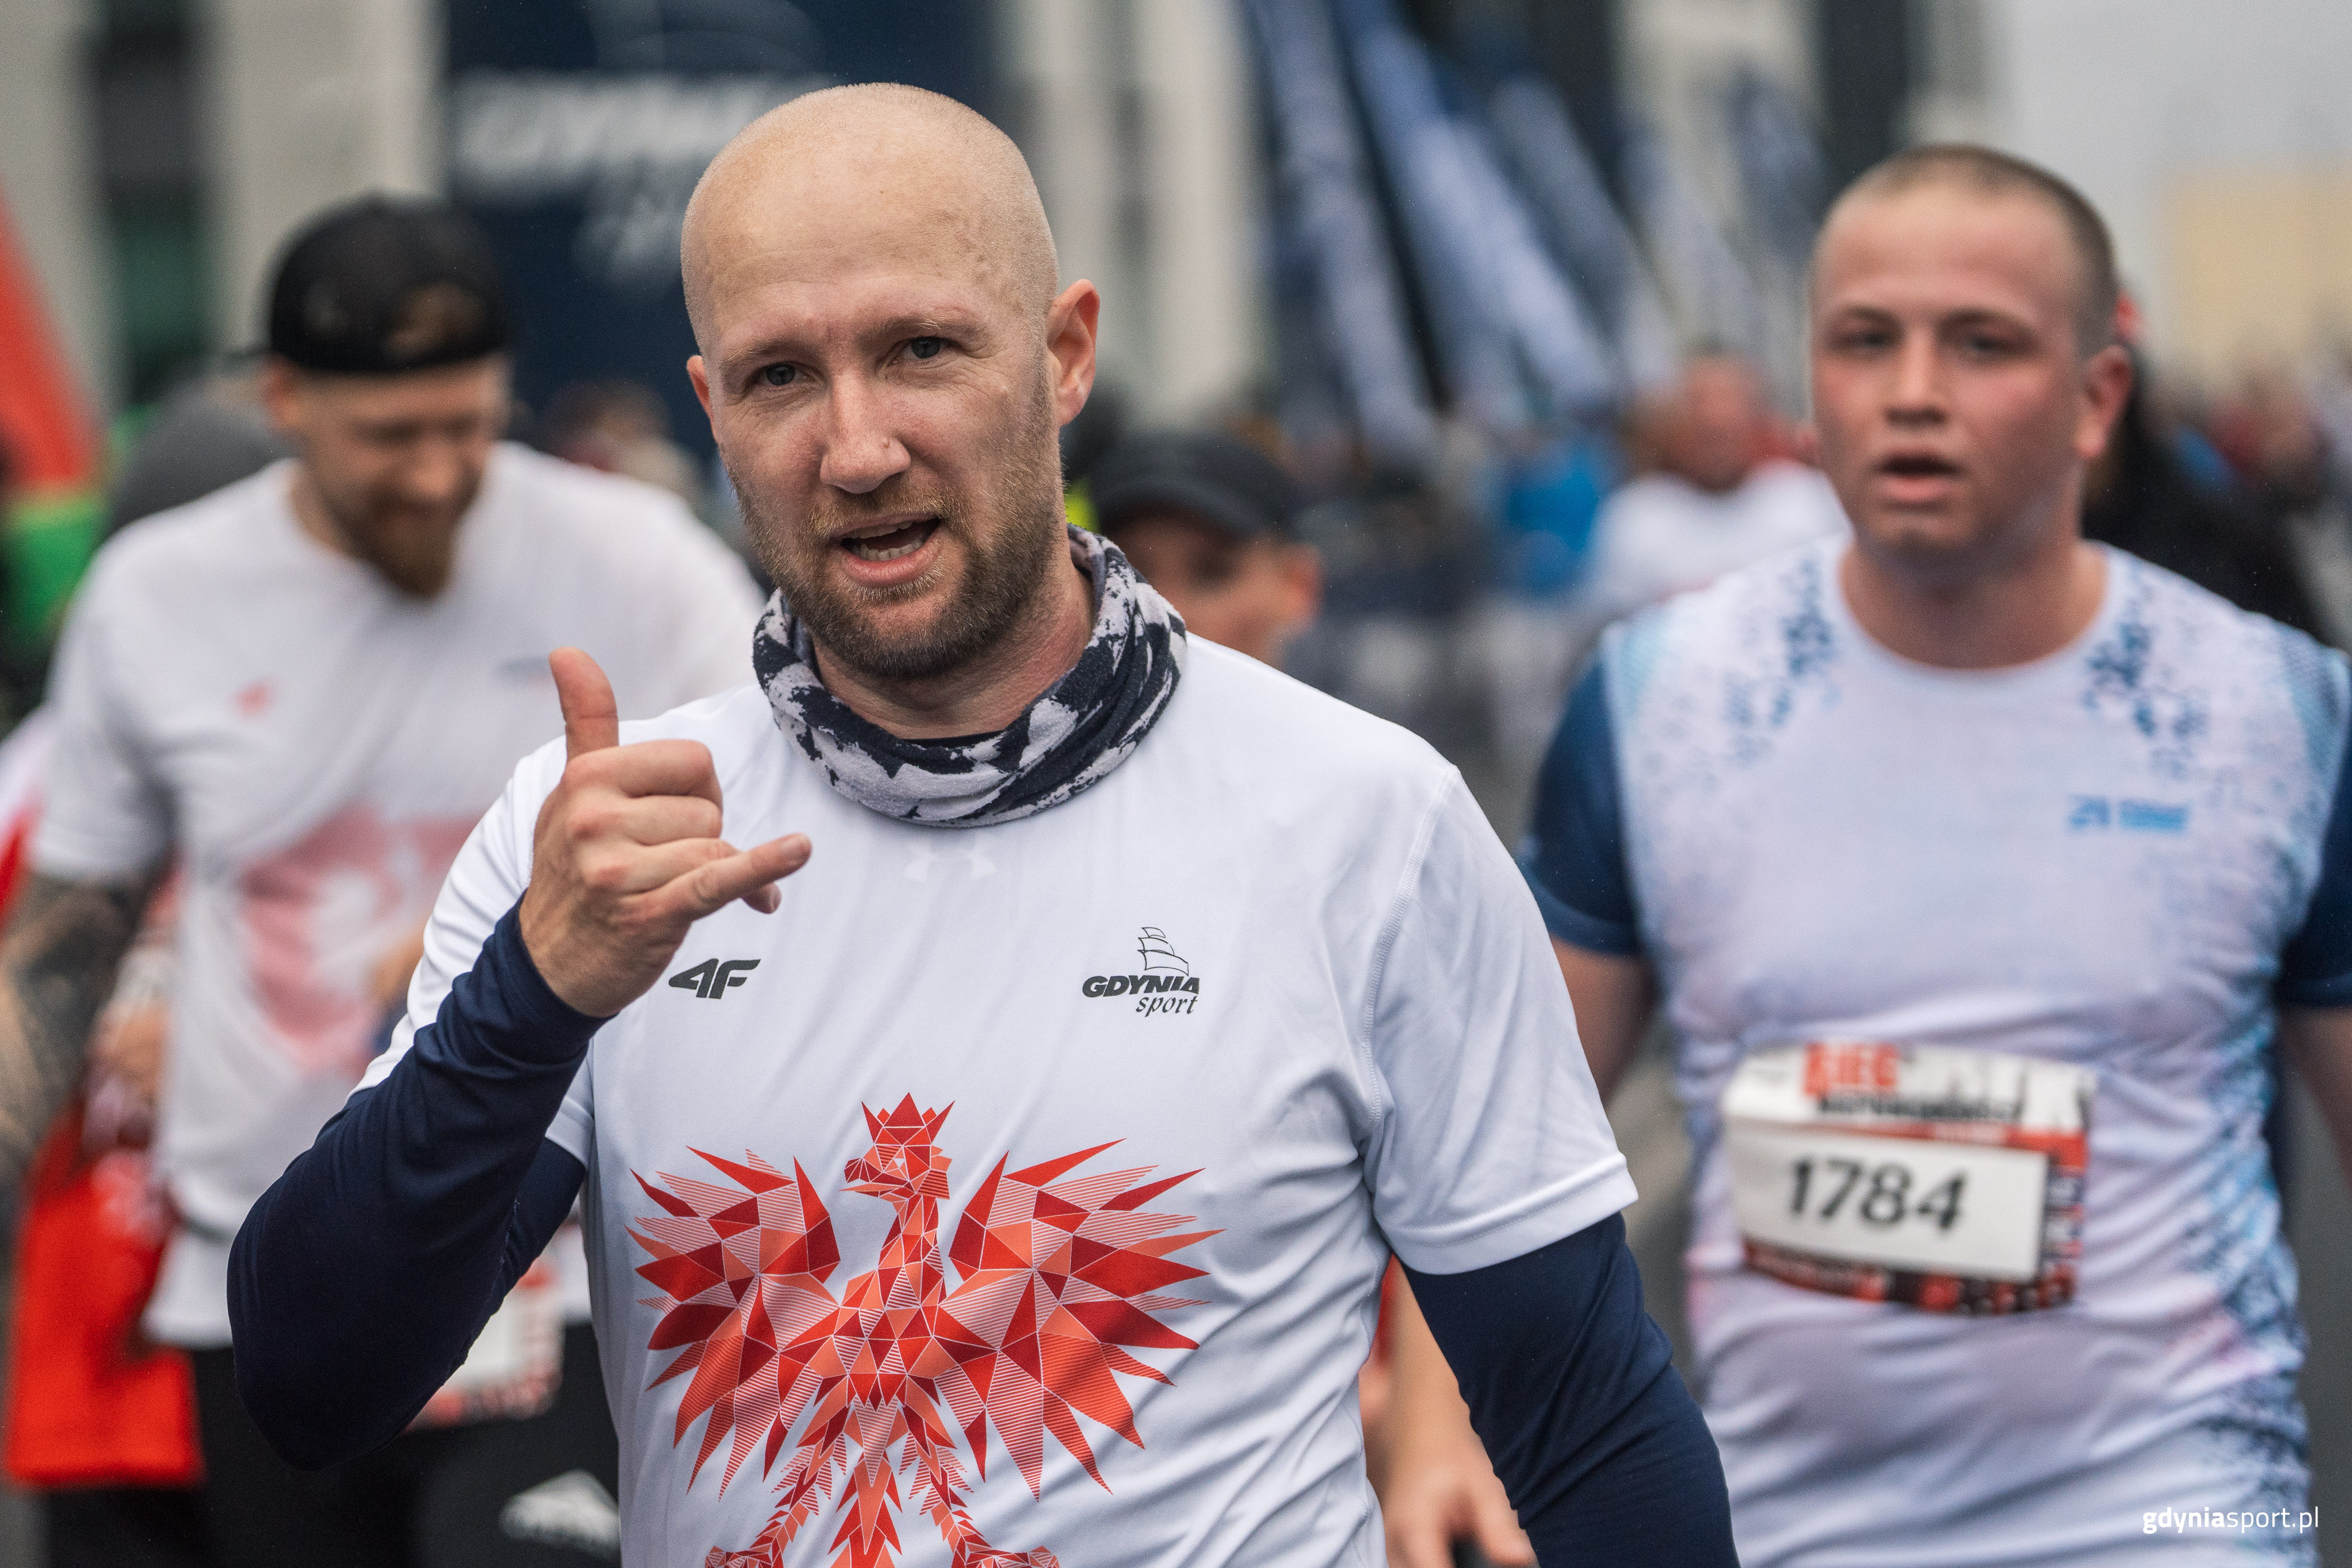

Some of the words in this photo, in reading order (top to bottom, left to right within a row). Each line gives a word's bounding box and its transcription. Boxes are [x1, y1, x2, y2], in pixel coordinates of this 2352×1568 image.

[1082, 975, 1200, 997] GDYNIA
[1135, 996, 1198, 1017] sport
[1788, 1151, 1970, 1236] 1784
